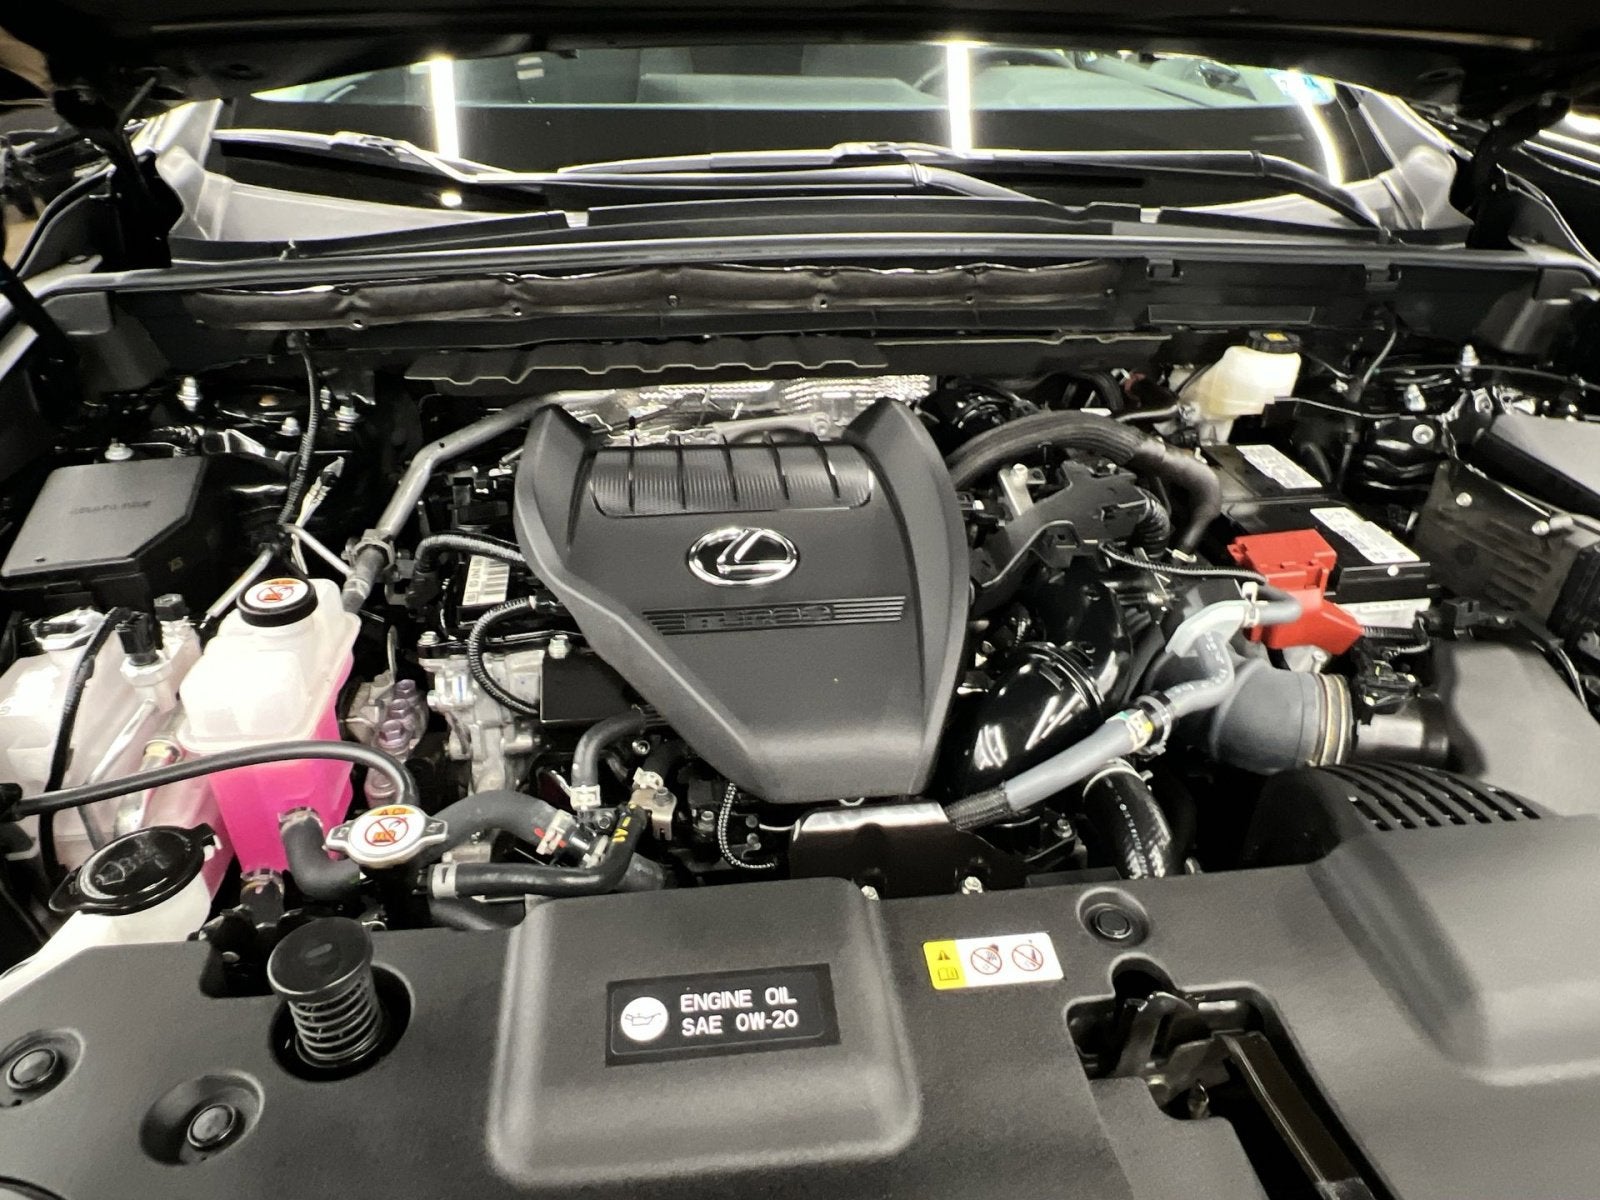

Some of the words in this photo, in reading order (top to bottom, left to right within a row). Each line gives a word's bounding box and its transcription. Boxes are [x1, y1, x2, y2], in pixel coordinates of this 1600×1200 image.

[680, 989, 753, 1013] ENGINE
[765, 986, 798, 1005] OIL
[681, 1015, 723, 1036] SAE
[736, 1009, 799, 1032] 0W-20
